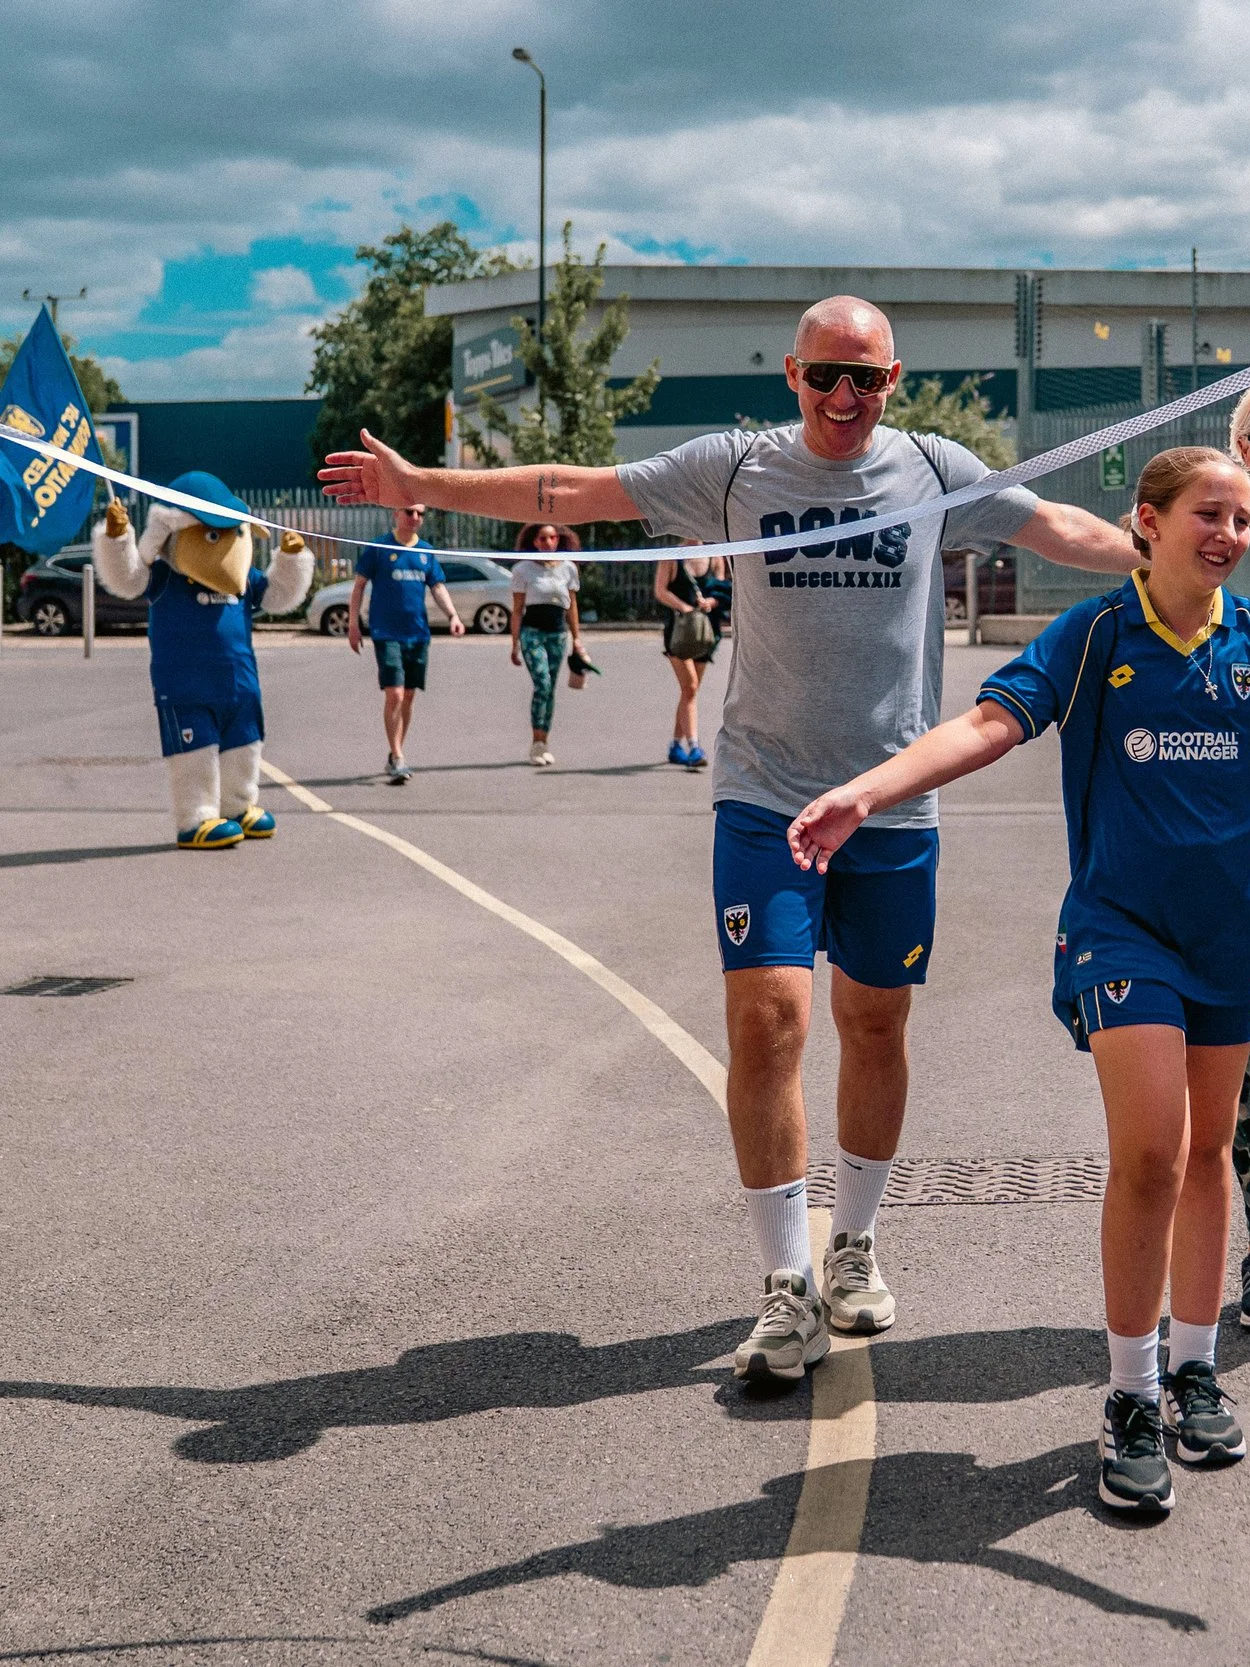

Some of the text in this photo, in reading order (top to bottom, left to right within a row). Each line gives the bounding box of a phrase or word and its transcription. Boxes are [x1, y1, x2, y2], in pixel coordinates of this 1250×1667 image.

[760, 506, 912, 568] DONS
[769, 571, 902, 588] MDCCCLXXXIX
[1159, 731, 1239, 746] FOOTBALL
[1158, 746, 1239, 761] MANAGER
